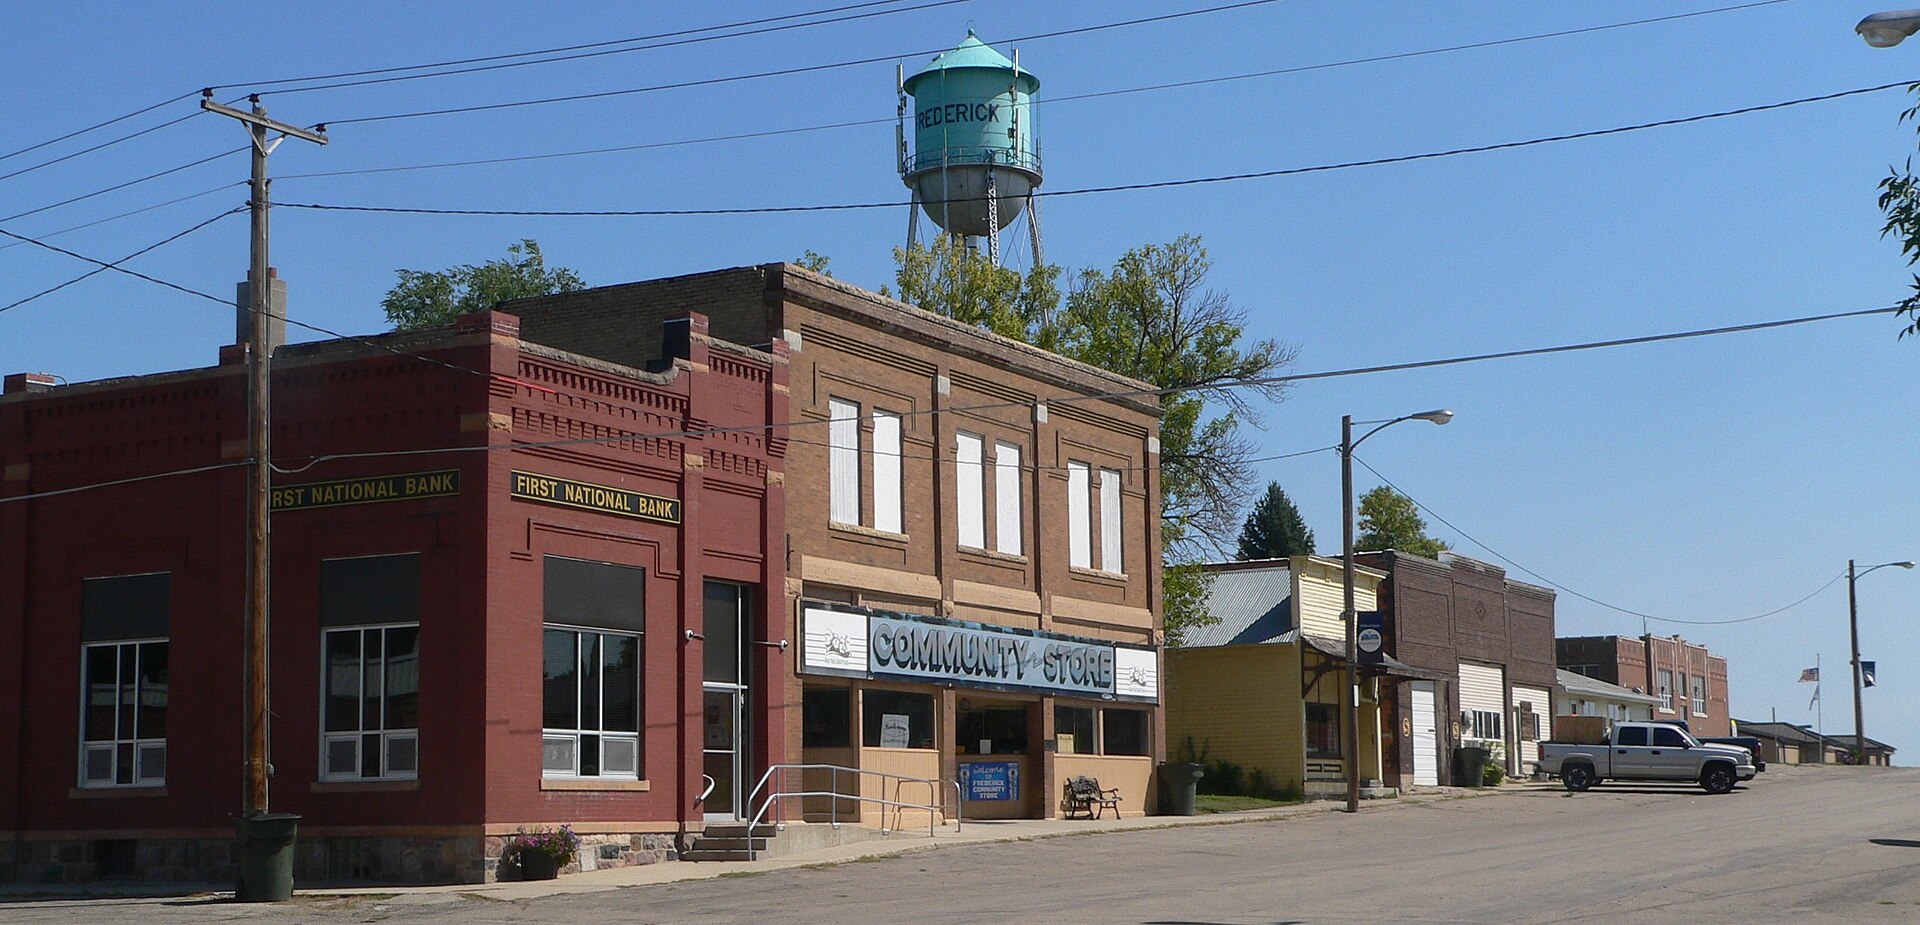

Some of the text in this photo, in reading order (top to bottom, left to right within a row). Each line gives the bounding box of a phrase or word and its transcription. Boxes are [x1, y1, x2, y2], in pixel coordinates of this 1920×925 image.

[273, 473, 454, 507] RST NATIONAL BANK
[517, 475, 673, 519] FIRST NATIONAL BANK
[873, 623, 1112, 689] COMMUNITY STORE
